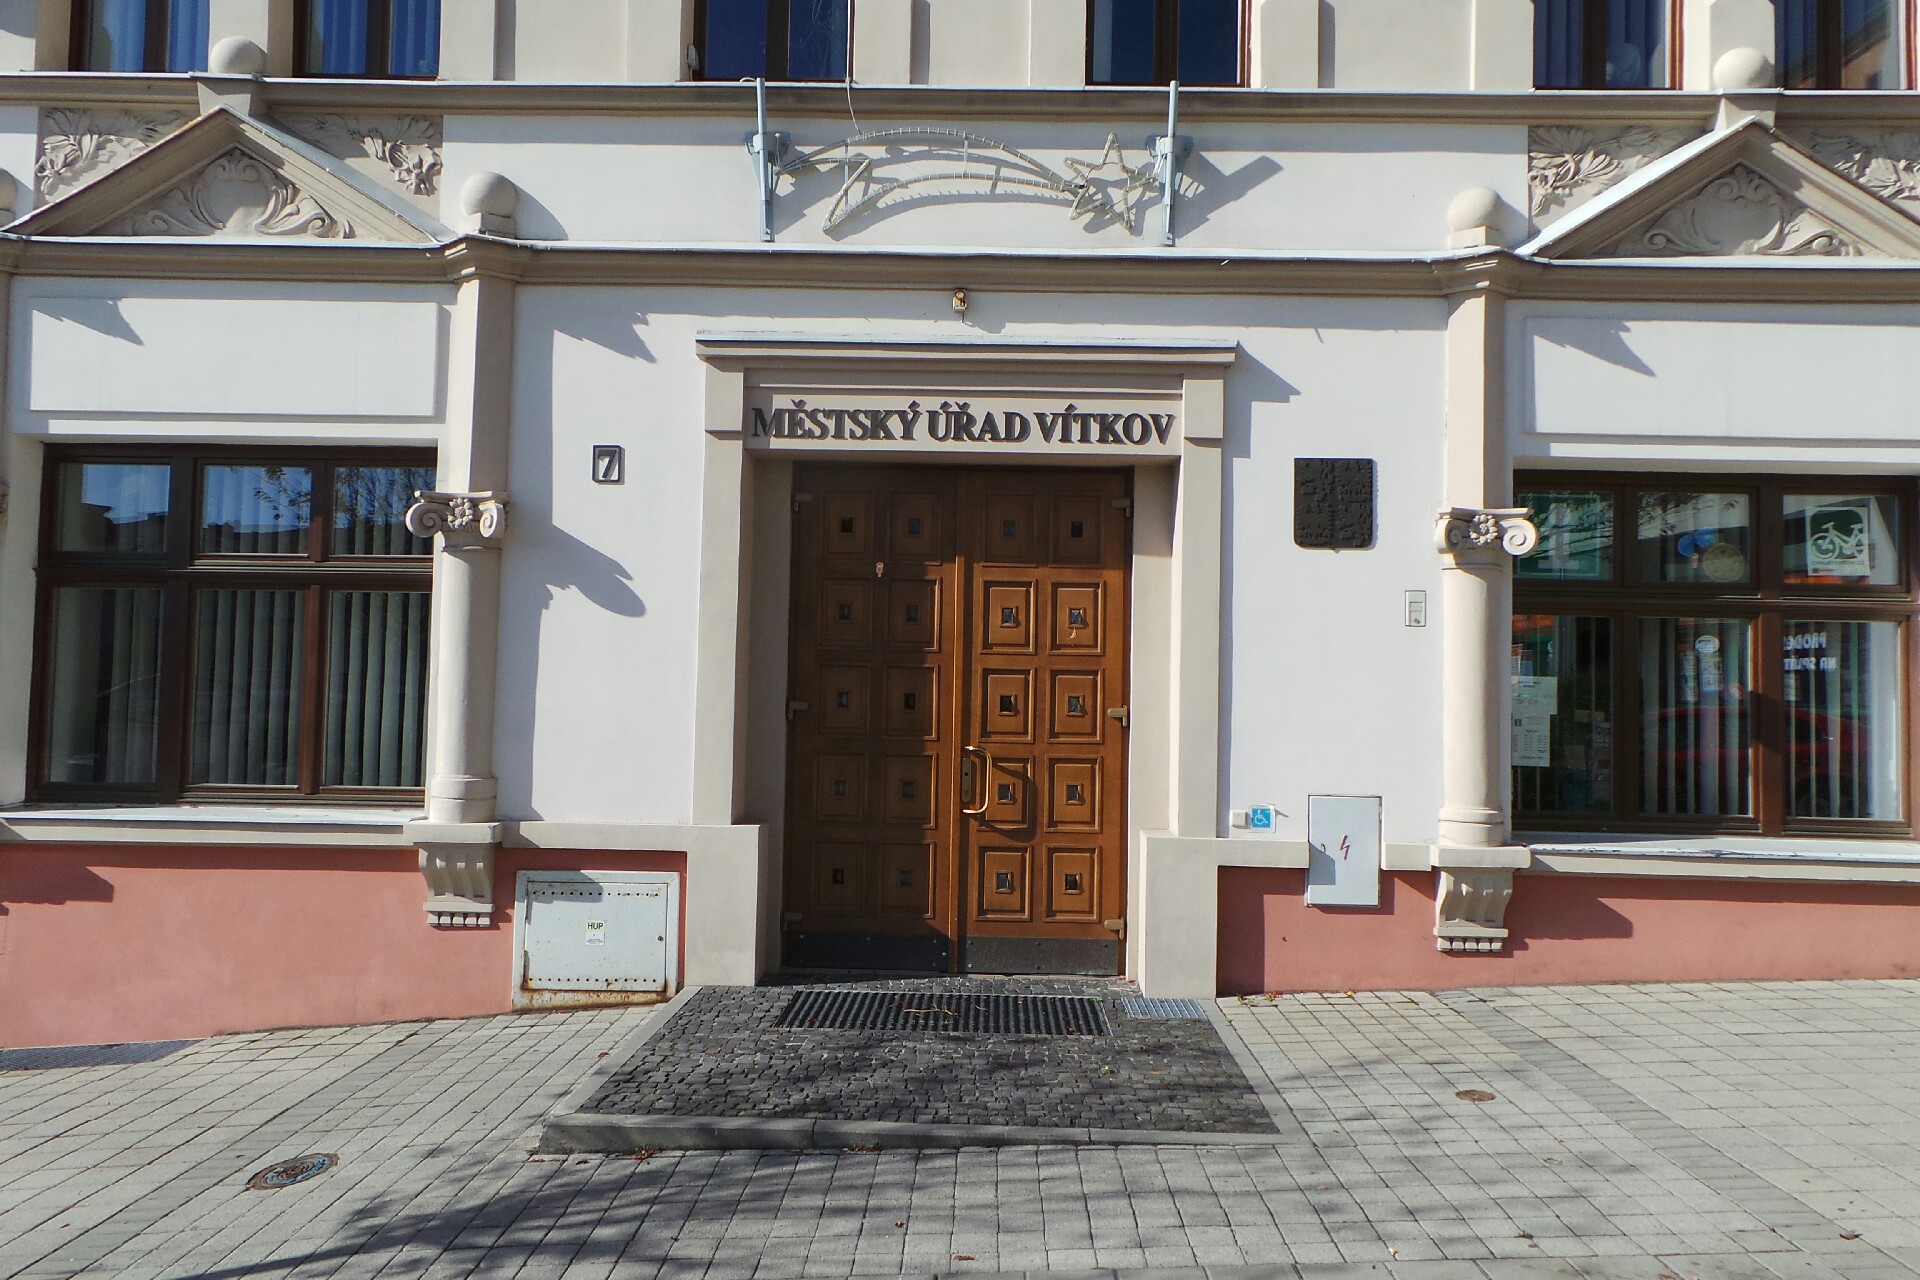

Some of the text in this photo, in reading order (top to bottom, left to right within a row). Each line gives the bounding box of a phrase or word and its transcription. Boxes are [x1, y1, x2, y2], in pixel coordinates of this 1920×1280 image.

[752, 399, 1177, 446] MĚSTSKÝ ÚŘAD VÍTKOV
[597, 449, 618, 479] 7
[587, 922, 604, 930] HUP
